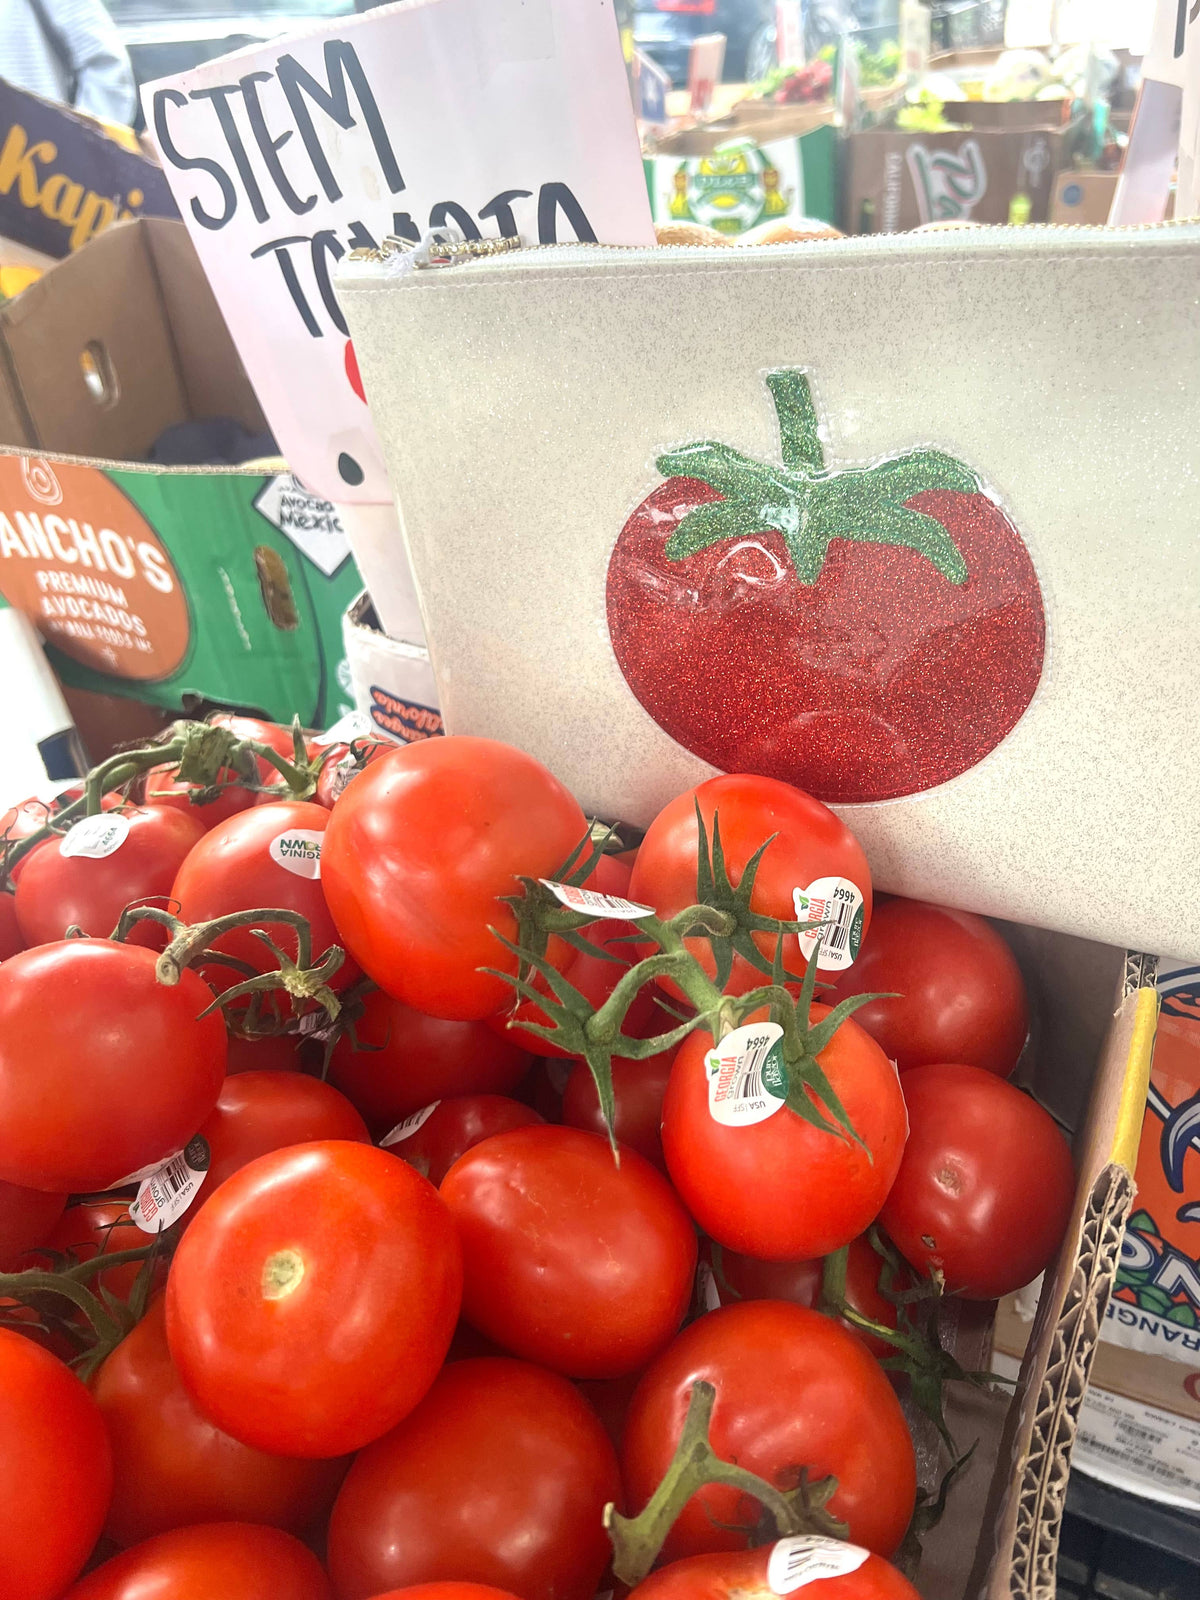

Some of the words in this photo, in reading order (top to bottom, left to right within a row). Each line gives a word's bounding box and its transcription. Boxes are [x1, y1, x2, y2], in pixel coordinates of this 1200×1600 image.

[152, 39, 406, 230] STEM
[251, 182, 598, 338] TOT
[280, 511, 344, 535] MEXIC
[35, 571, 129, 609] PREMIUM
[42, 596, 147, 637] AVOCADOS
[280, 839, 321, 851] ROWN
[281, 848, 321, 860] RGINIA
[833, 886, 855, 904] 4664
[746, 1035, 770, 1051] 4664
[714, 1055, 738, 1103] GEORGIA
[726, 1055, 744, 1100] grown
